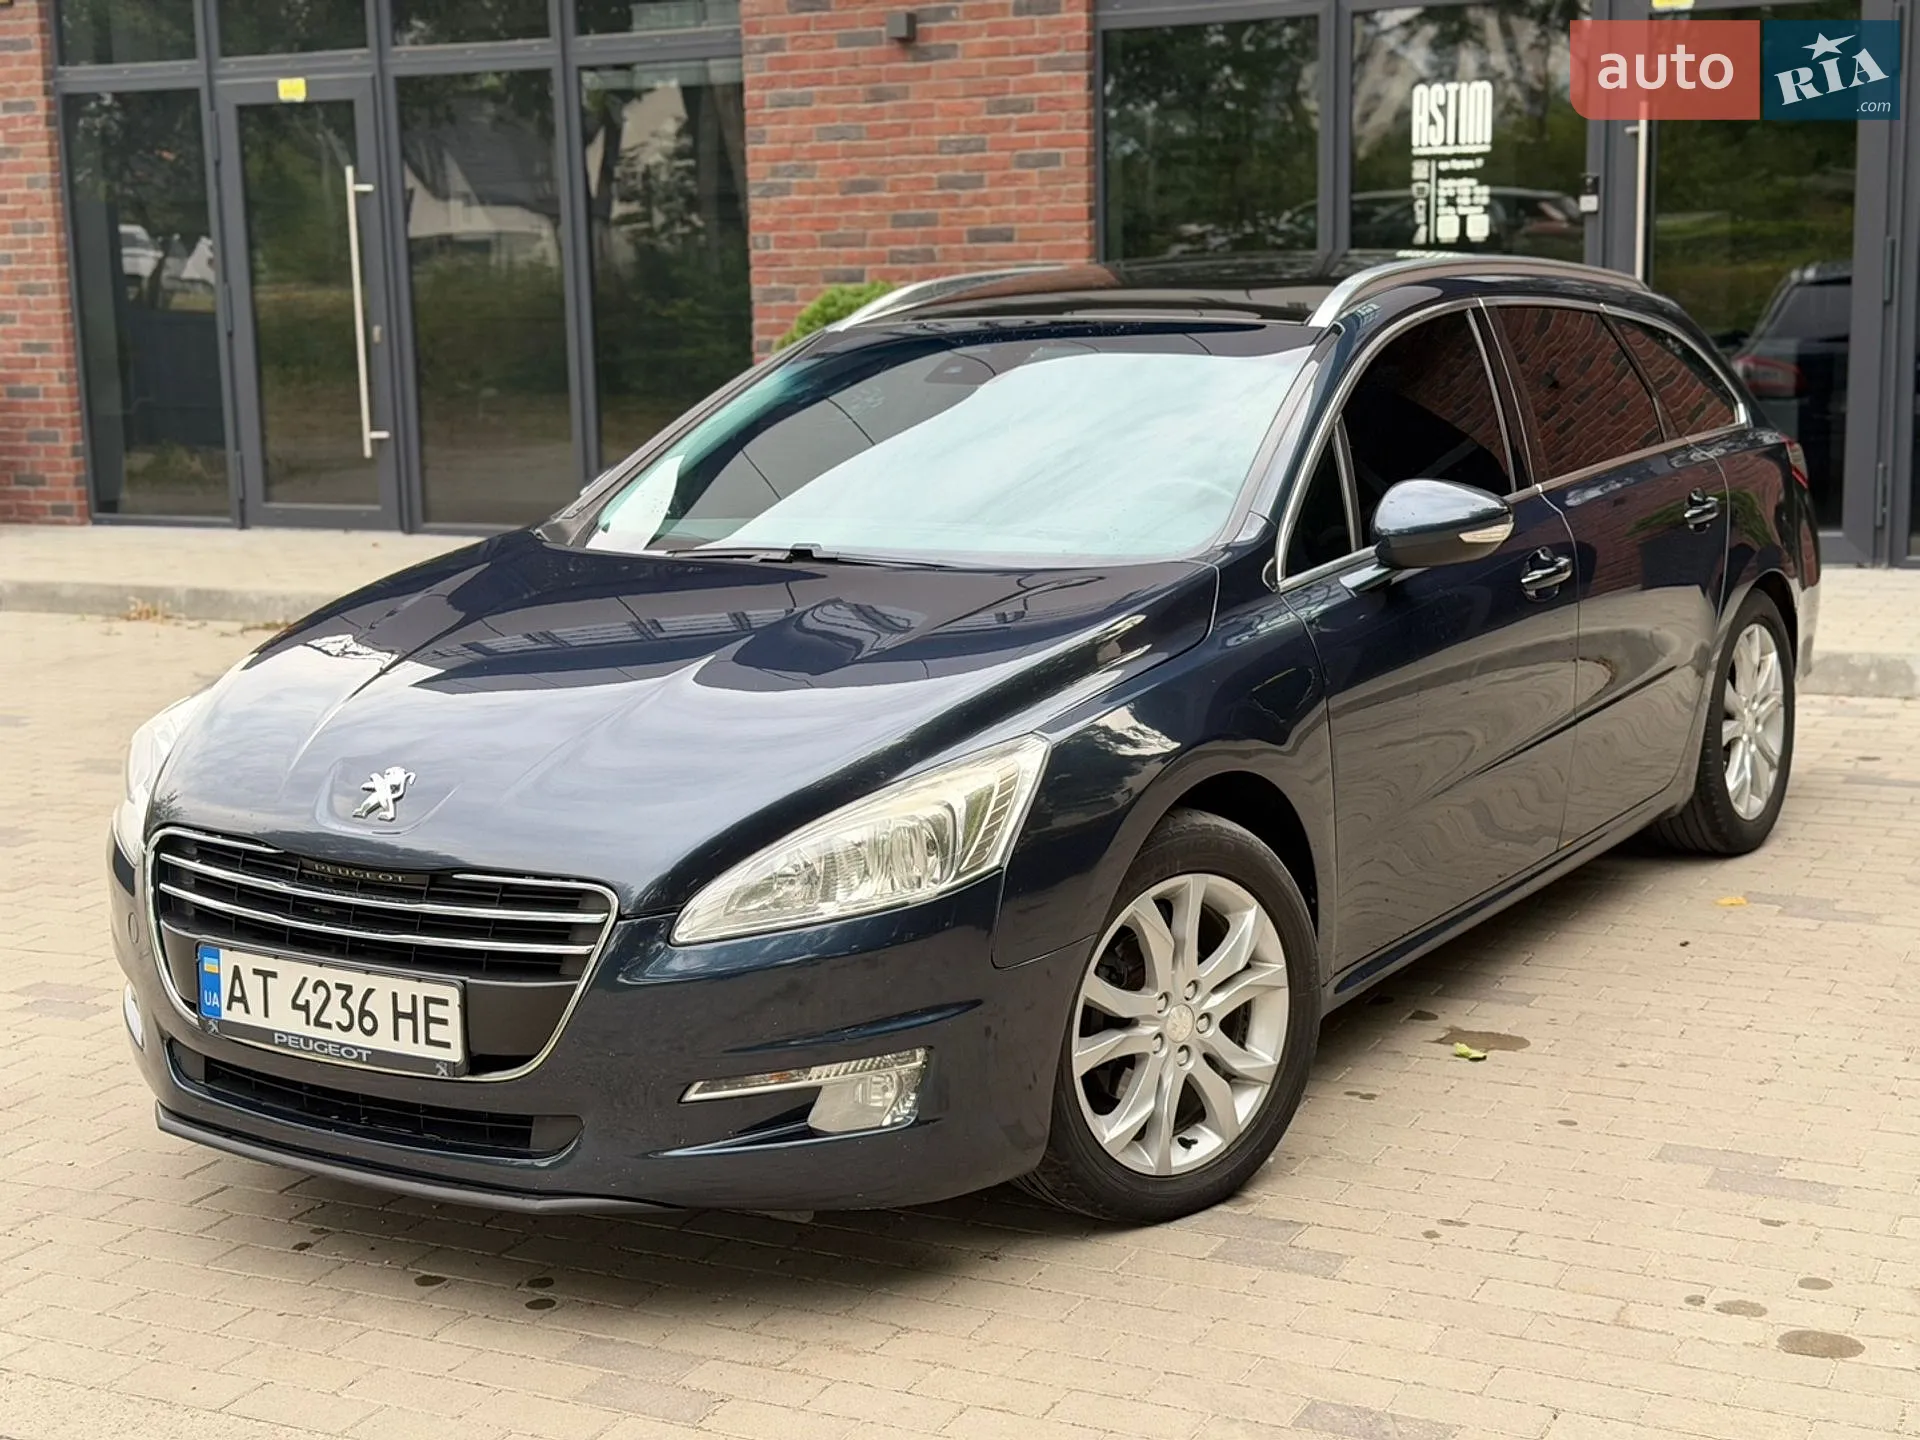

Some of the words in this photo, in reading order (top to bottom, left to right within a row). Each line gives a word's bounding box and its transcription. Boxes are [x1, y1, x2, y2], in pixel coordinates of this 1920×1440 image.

[1411, 81, 1493, 147] ASTIM
[314, 863, 406, 883] PEUGEOT
[204, 993, 220, 1008] UA
[226, 964, 278, 1019] AT
[290, 976, 379, 1036] 4236
[391, 991, 452, 1049] HE
[273, 1032, 372, 1062] PEUGEOT
